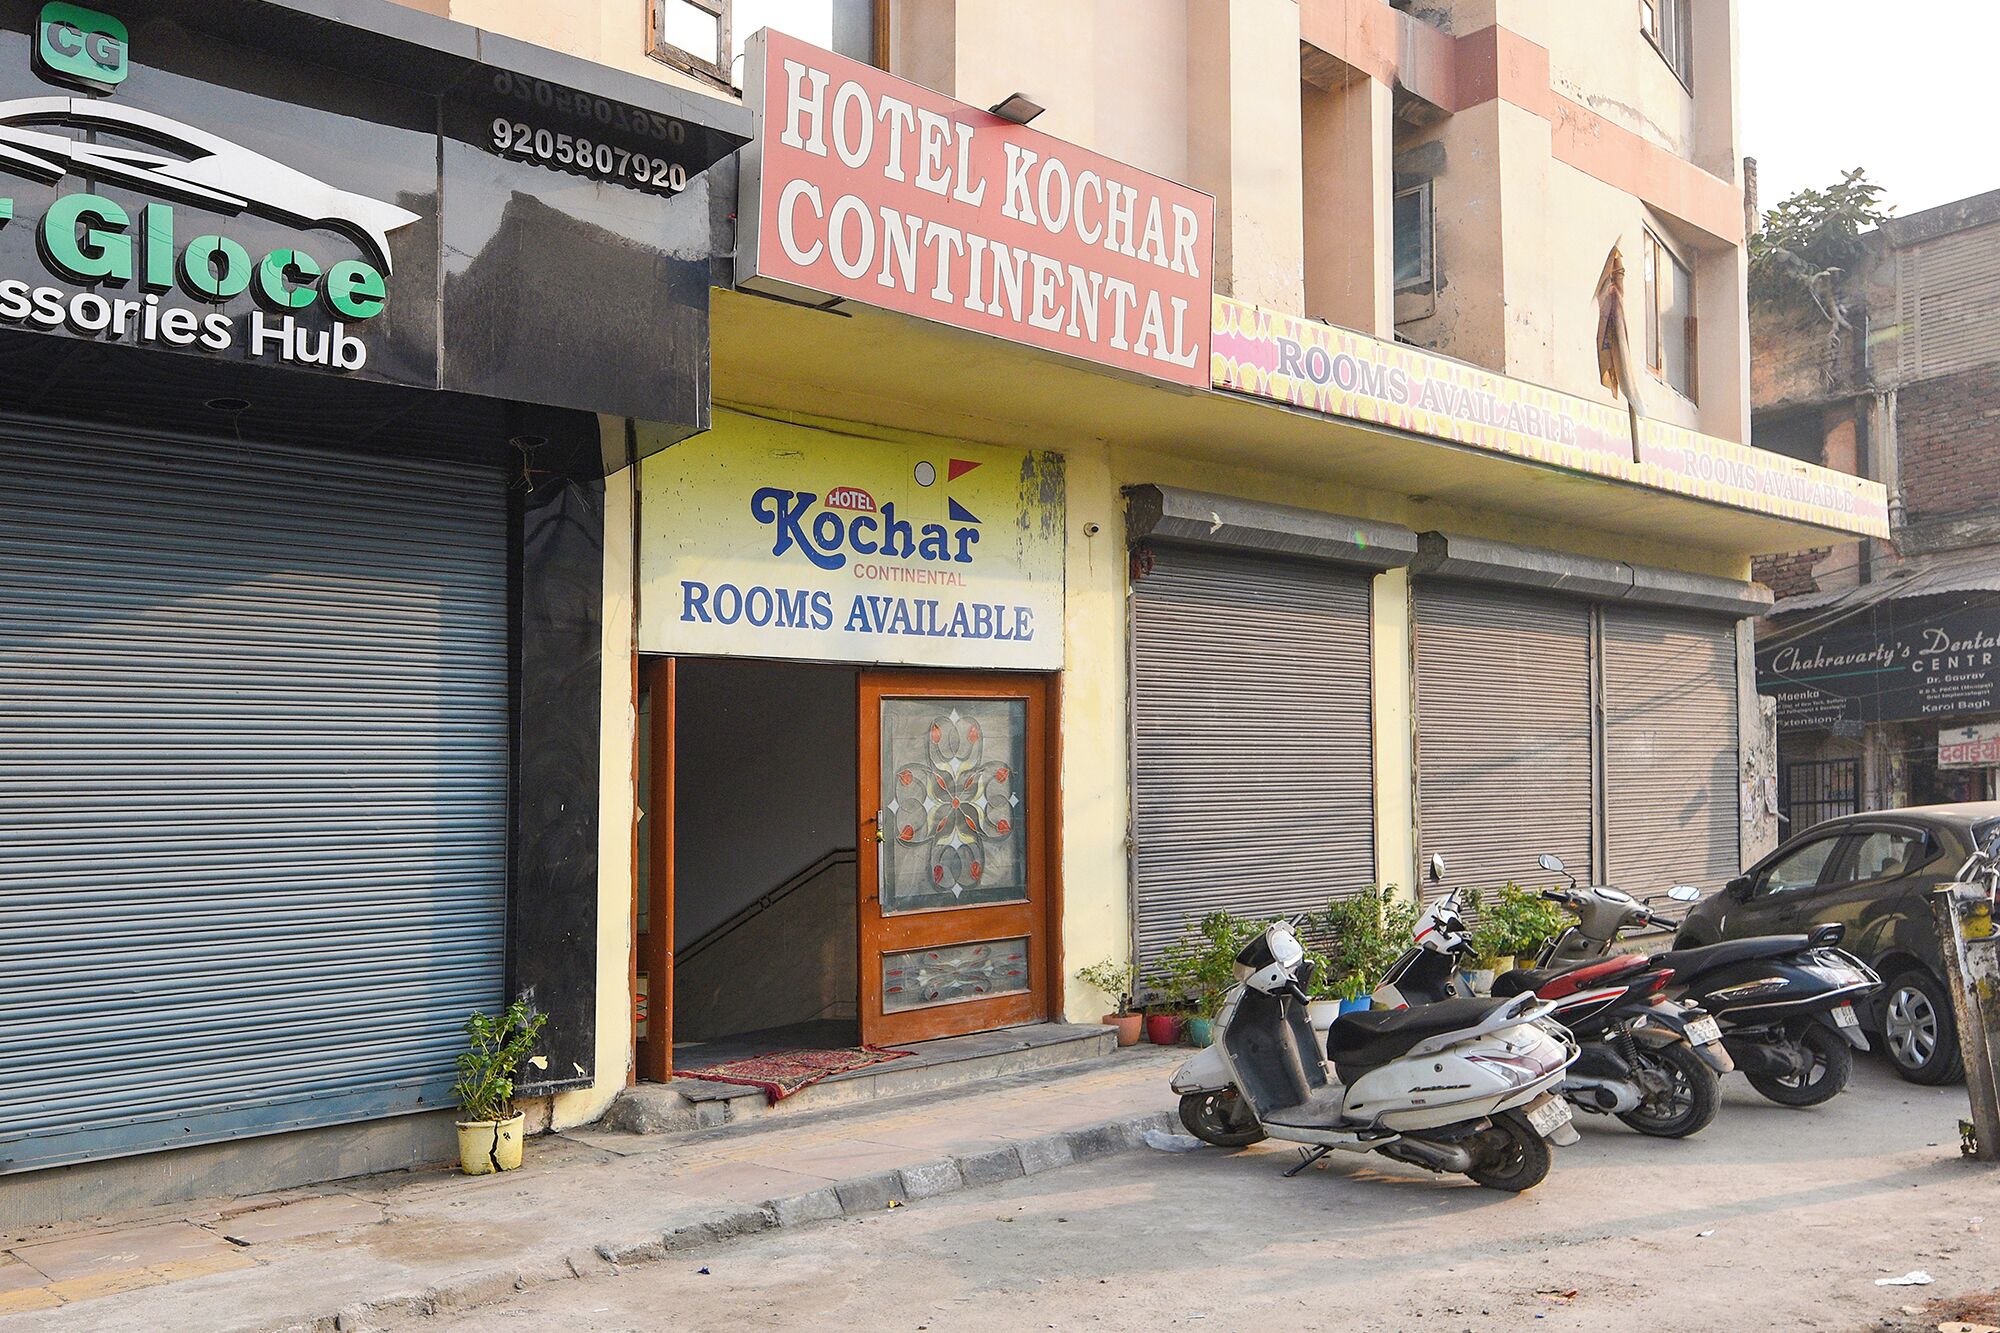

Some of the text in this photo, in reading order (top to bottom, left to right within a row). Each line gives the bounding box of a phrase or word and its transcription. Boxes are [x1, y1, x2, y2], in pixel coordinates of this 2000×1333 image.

[47, 23, 120, 67] CG
[492, 117, 687, 192] 9205807920
[781, 58, 1200, 279] HOTEL KOCHAR
[45, 193, 386, 318] Gloce
[777, 178, 1199, 369] CONTINENTAL
[0, 280, 367, 370] ssories Hub
[1276, 336, 1576, 446] ROOMS AVAILABLE
[828, 490, 875, 511] HOTEL
[1682, 448, 1854, 513] ROOMS AVAILABLE
[750, 487, 980, 571] Kochar
[853, 563, 967, 587] CONTINENTAL
[680, 581, 1035, 642] ROOMS AVAILABLE
[1772, 642, 1911, 674] Chakravarty's
[1922, 699, 1991, 713] Karol Bagh
